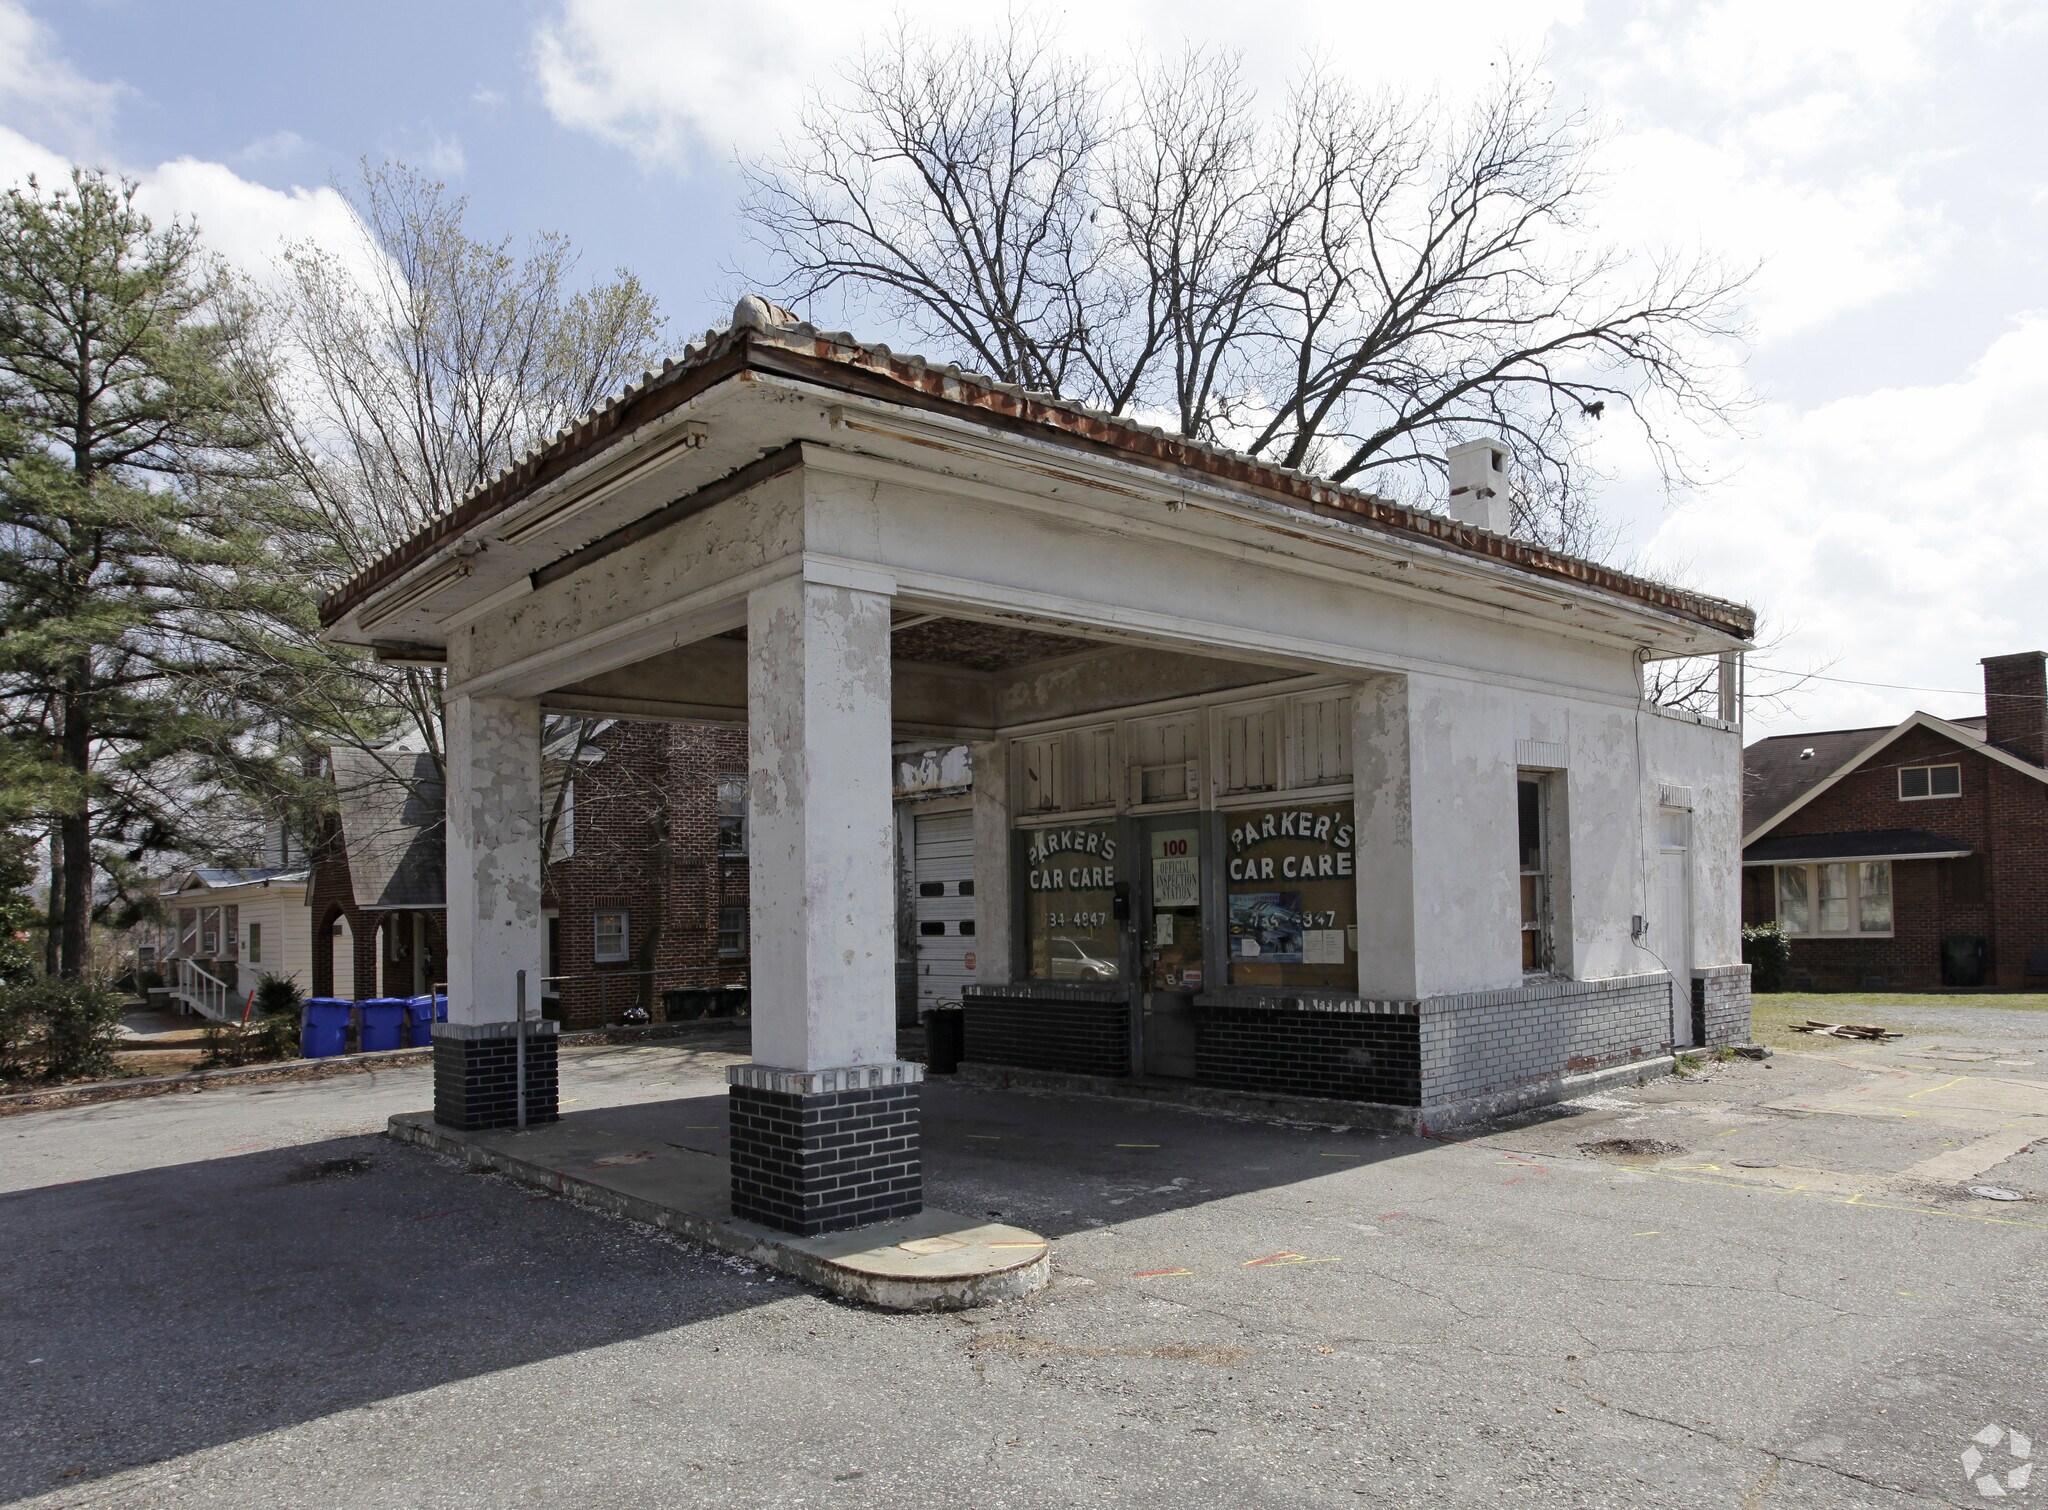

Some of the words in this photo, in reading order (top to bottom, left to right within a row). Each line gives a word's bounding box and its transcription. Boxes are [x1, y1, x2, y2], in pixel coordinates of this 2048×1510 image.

[1231, 811, 1354, 852] PARKER'S
[1029, 830, 1116, 867] PARKER'S
[1163, 839, 1188, 857] 100
[1160, 860, 1190, 874] OFFICIAL
[1230, 857, 1275, 880] CAR
[1282, 852, 1352, 878] CARE
[1030, 869, 1064, 889] CAR
[1069, 865, 1115, 887] CARE
[1156, 873, 1197, 888] INSPECTION
[1162, 886, 1191, 900] STATION
